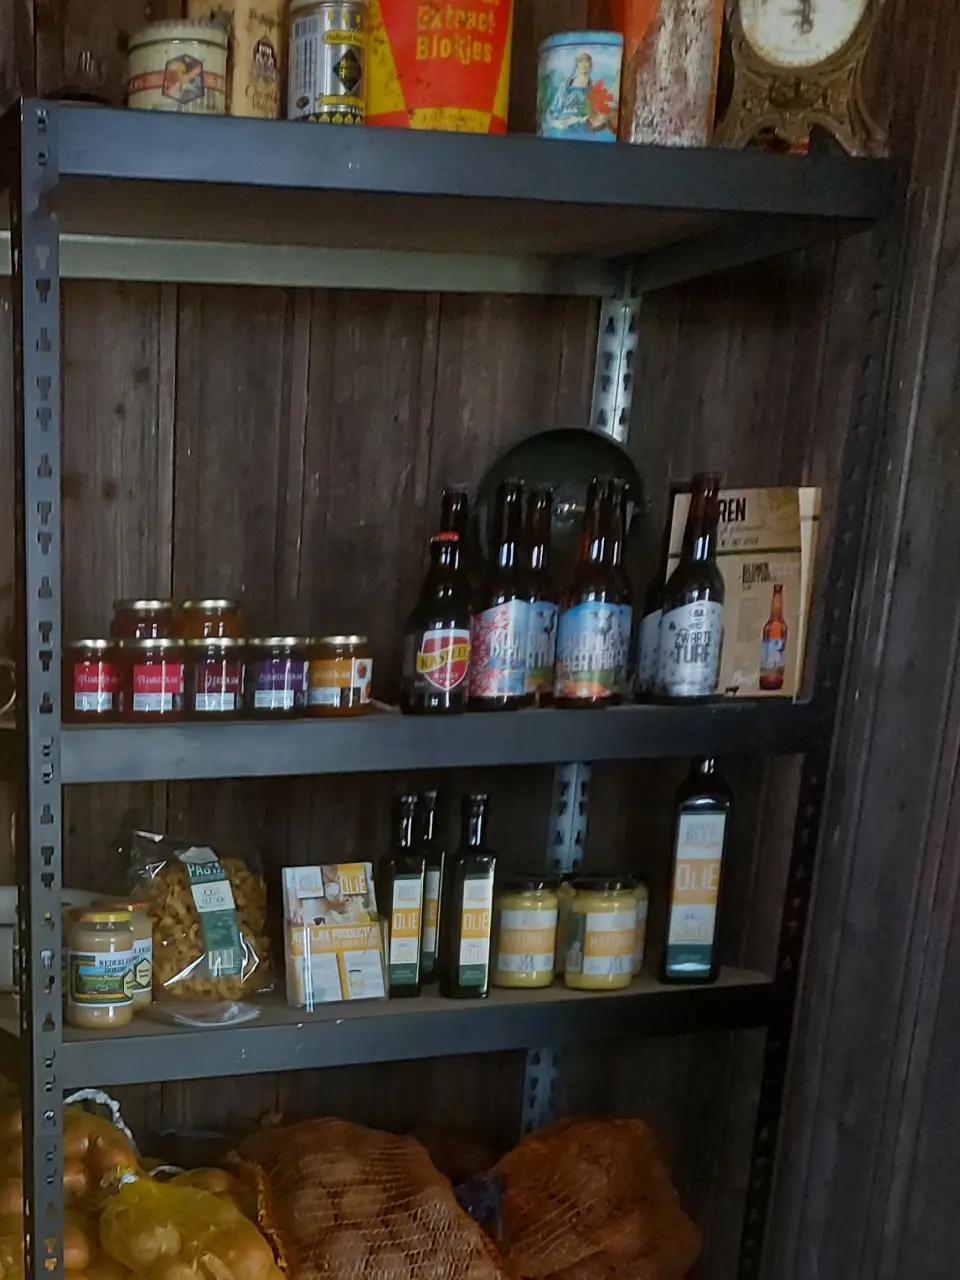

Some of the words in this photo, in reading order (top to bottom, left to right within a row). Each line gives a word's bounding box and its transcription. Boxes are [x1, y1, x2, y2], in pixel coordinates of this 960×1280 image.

[417, 5, 495, 33] Extract
[416, 36, 492, 65] Blokjes
[340, 876, 367, 895] OLIE
[677, 864, 720, 890] OLIE
[394, 912, 418, 930] OLIE
[464, 911, 490, 930] OLIE
